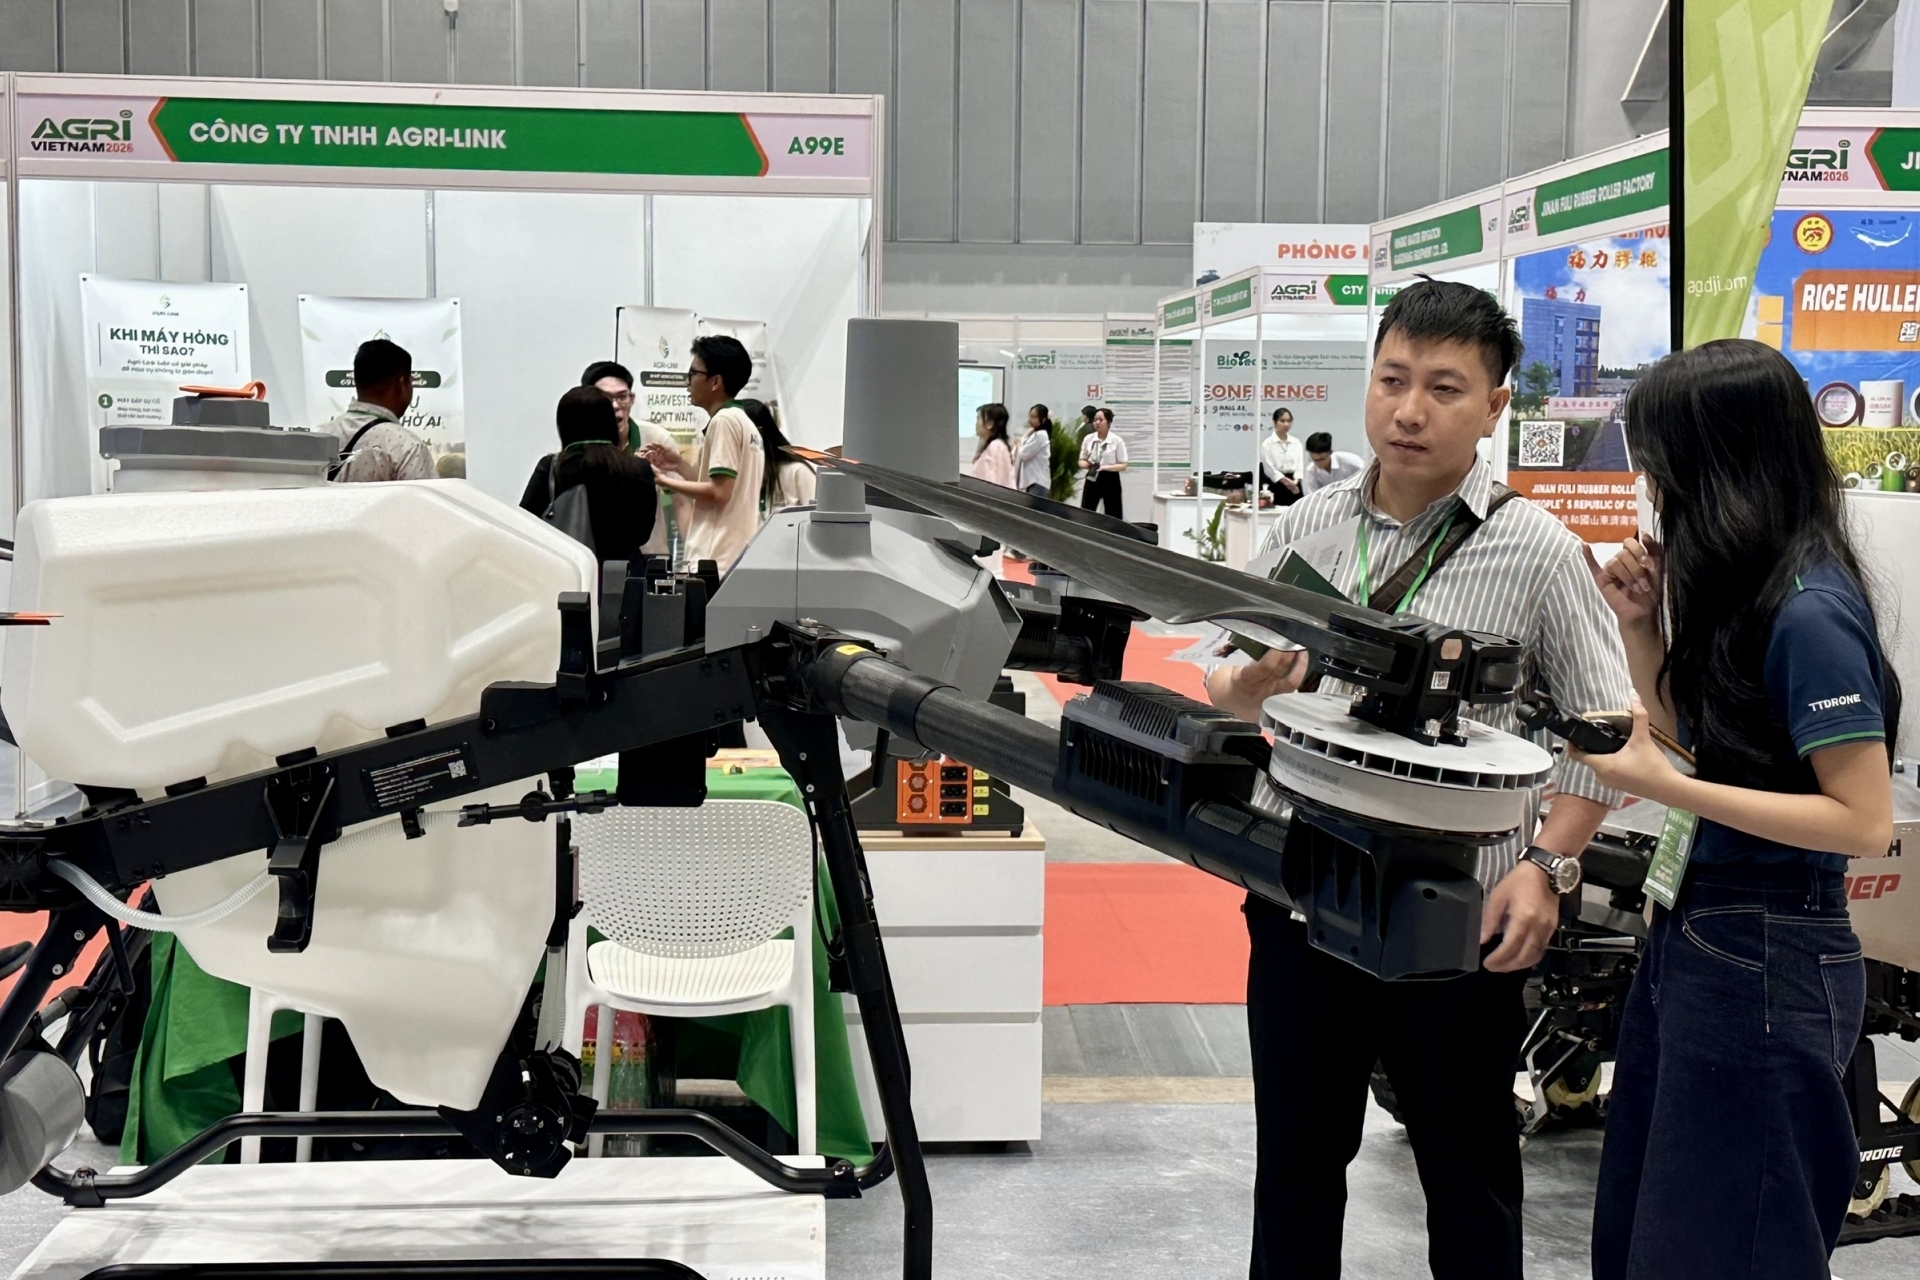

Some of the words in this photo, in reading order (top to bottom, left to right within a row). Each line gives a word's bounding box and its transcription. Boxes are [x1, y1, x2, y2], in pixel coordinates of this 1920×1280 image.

[31, 109, 133, 141] AGRI
[189, 117, 269, 143] CÔNG
[275, 124, 304, 144] TY
[310, 125, 377, 146] TNHH
[385, 126, 507, 149] AGRI-LINK
[31, 141, 134, 153] VIETNAM2026
[787, 136, 844, 156] A99E
[1785, 139, 1851, 170] GRI
[1900, 151, 1920, 170] JI
[1781, 171, 1849, 182] TNAM2026
[1278, 239, 1357, 260] PHÒNG
[1271, 280, 1318, 295] AGRI
[1342, 285, 1364, 295] CTY
[1801, 283, 1848, 312] RICE
[110, 328, 138, 341] KHI
[141, 327, 179, 343] MÁY
[162, 346, 195, 356] SAO?
[1204, 384, 1328, 400] CONFRENCE
[1611, 484, 1637, 495] ROLLE
[1808, 693, 1861, 712] TTDRONE
